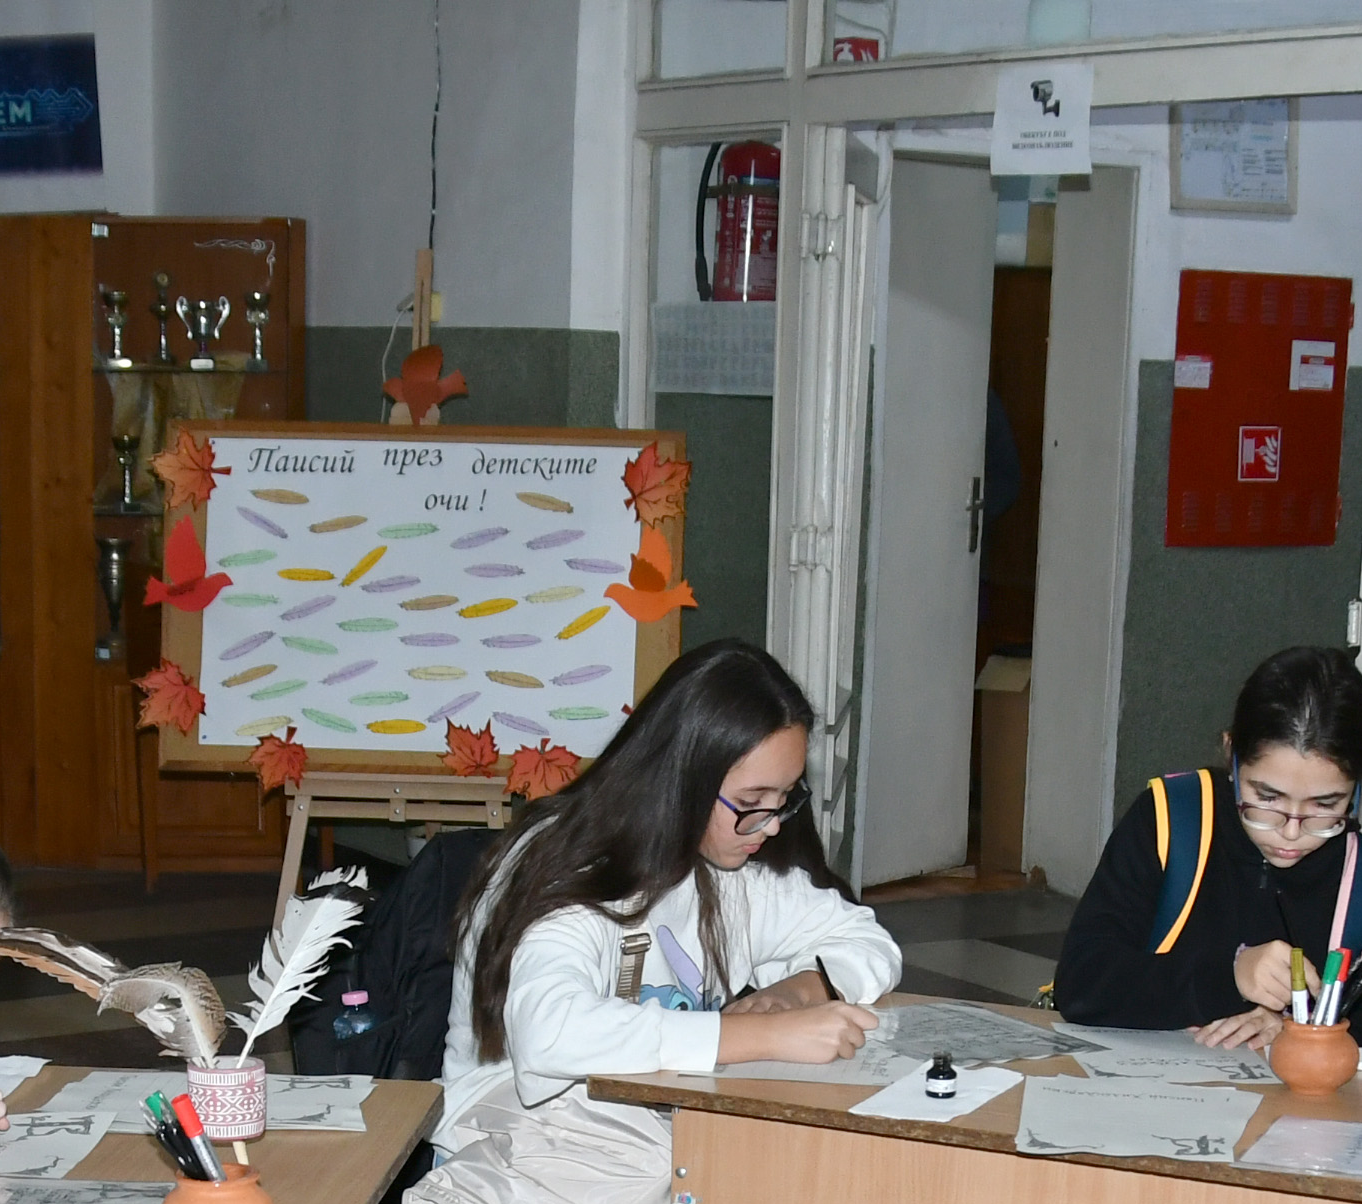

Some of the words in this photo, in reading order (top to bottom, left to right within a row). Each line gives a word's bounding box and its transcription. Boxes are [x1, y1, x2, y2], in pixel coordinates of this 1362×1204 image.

[247, 446, 355, 473] Паисий
[382, 447, 444, 476] през
[471, 448, 598, 481] детските
